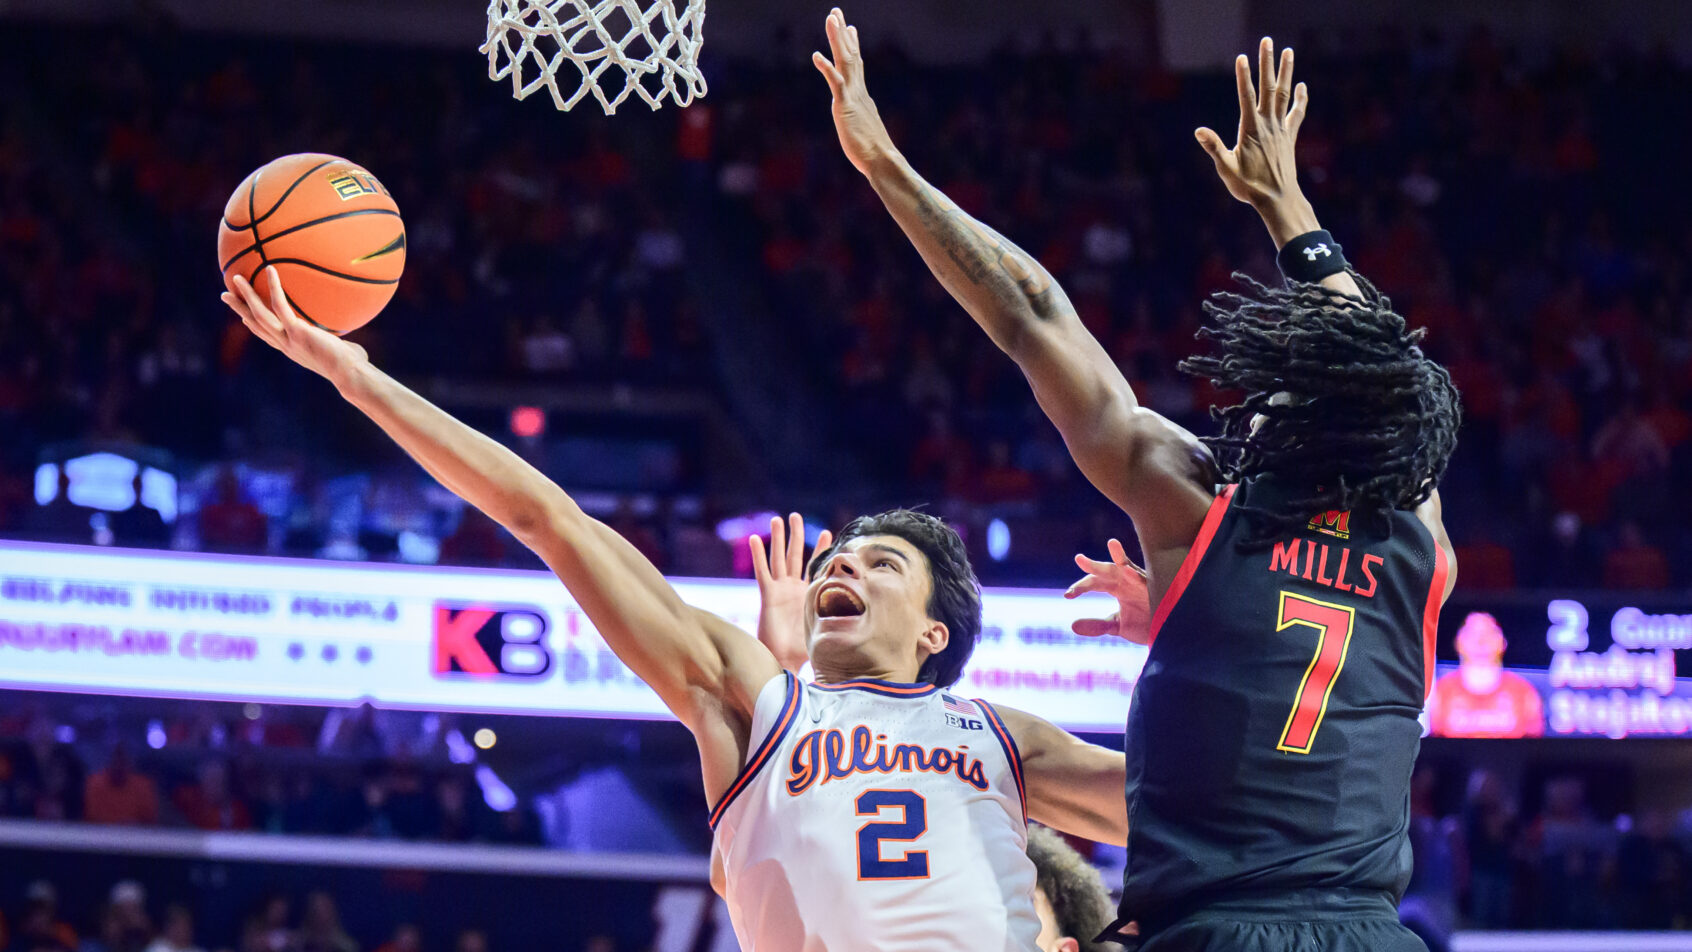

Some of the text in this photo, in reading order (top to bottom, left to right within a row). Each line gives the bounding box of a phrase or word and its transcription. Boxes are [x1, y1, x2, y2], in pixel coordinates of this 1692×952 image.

[328, 170, 391, 201] ELIT
[1268, 537, 1385, 598] MILLS
[1547, 599, 1589, 651] 2
[1276, 590, 1356, 754] 7
[786, 724, 990, 797] Illinois
[854, 788, 931, 882] 2
